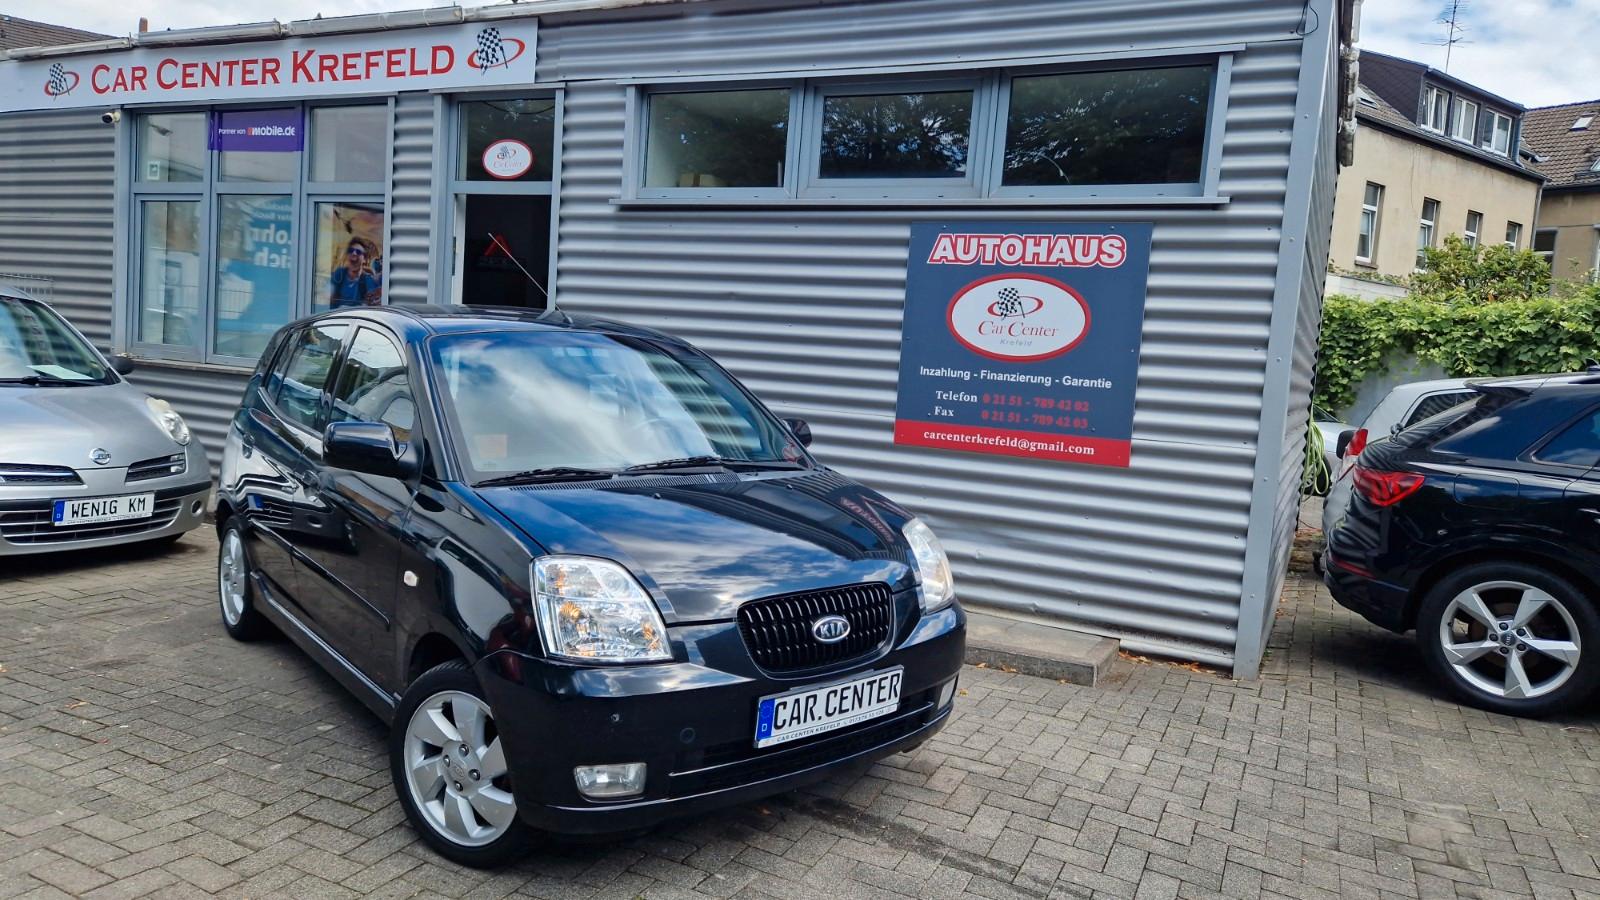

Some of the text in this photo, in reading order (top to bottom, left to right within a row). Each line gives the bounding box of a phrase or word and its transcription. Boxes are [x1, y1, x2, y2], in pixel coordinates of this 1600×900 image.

[91, 45, 456, 95] CAR CENTER KREFELD
[927, 233, 1127, 268] AUTOHAUS
[978, 320, 1059, 337] Car Center
[920, 366, 971, 381] Inzahlung
[980, 370, 1052, 387] Finanzierung
[1062, 375, 1113, 389] Garantie
[936, 390, 978, 403] Telefon
[934, 405, 955, 417] Fax
[923, 430, 1095, 455] carcenterkrefeld@gmail.com
[71, 499, 118, 519] WENIG
[128, 497, 147, 513] KM
[819, 621, 845, 639] KIA
[761, 723, 768, 732] D
[774, 672, 901, 731] CAR.CENTER
